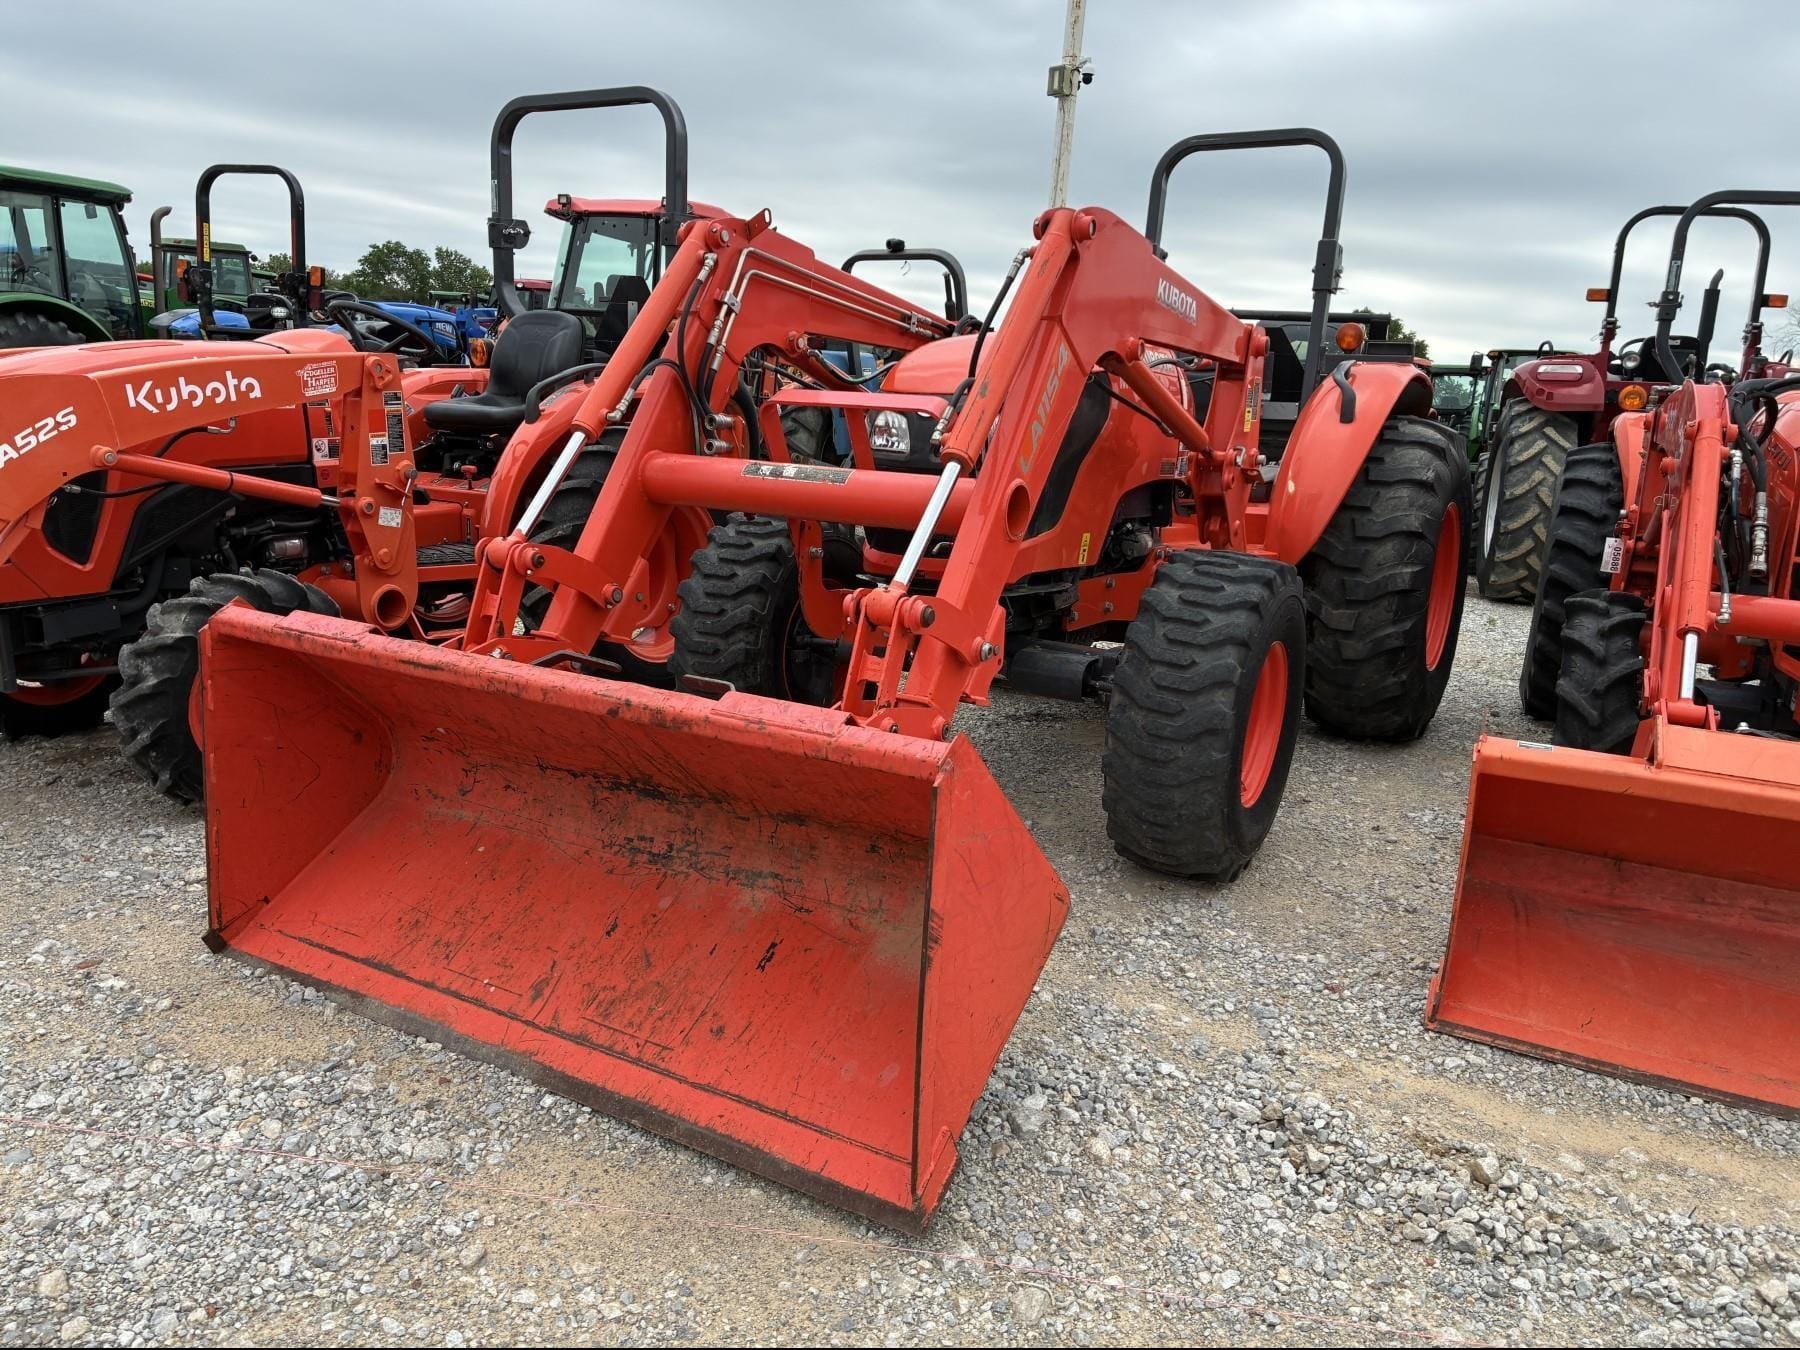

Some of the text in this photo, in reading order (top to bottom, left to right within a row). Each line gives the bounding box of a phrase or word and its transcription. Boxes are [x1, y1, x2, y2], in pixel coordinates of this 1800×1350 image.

[1157, 277, 1196, 322] KUBOTA
[125, 370, 262, 414] Kubota
[308, 377, 335, 388] HARPER
[1019, 341, 1068, 475] LA1154
